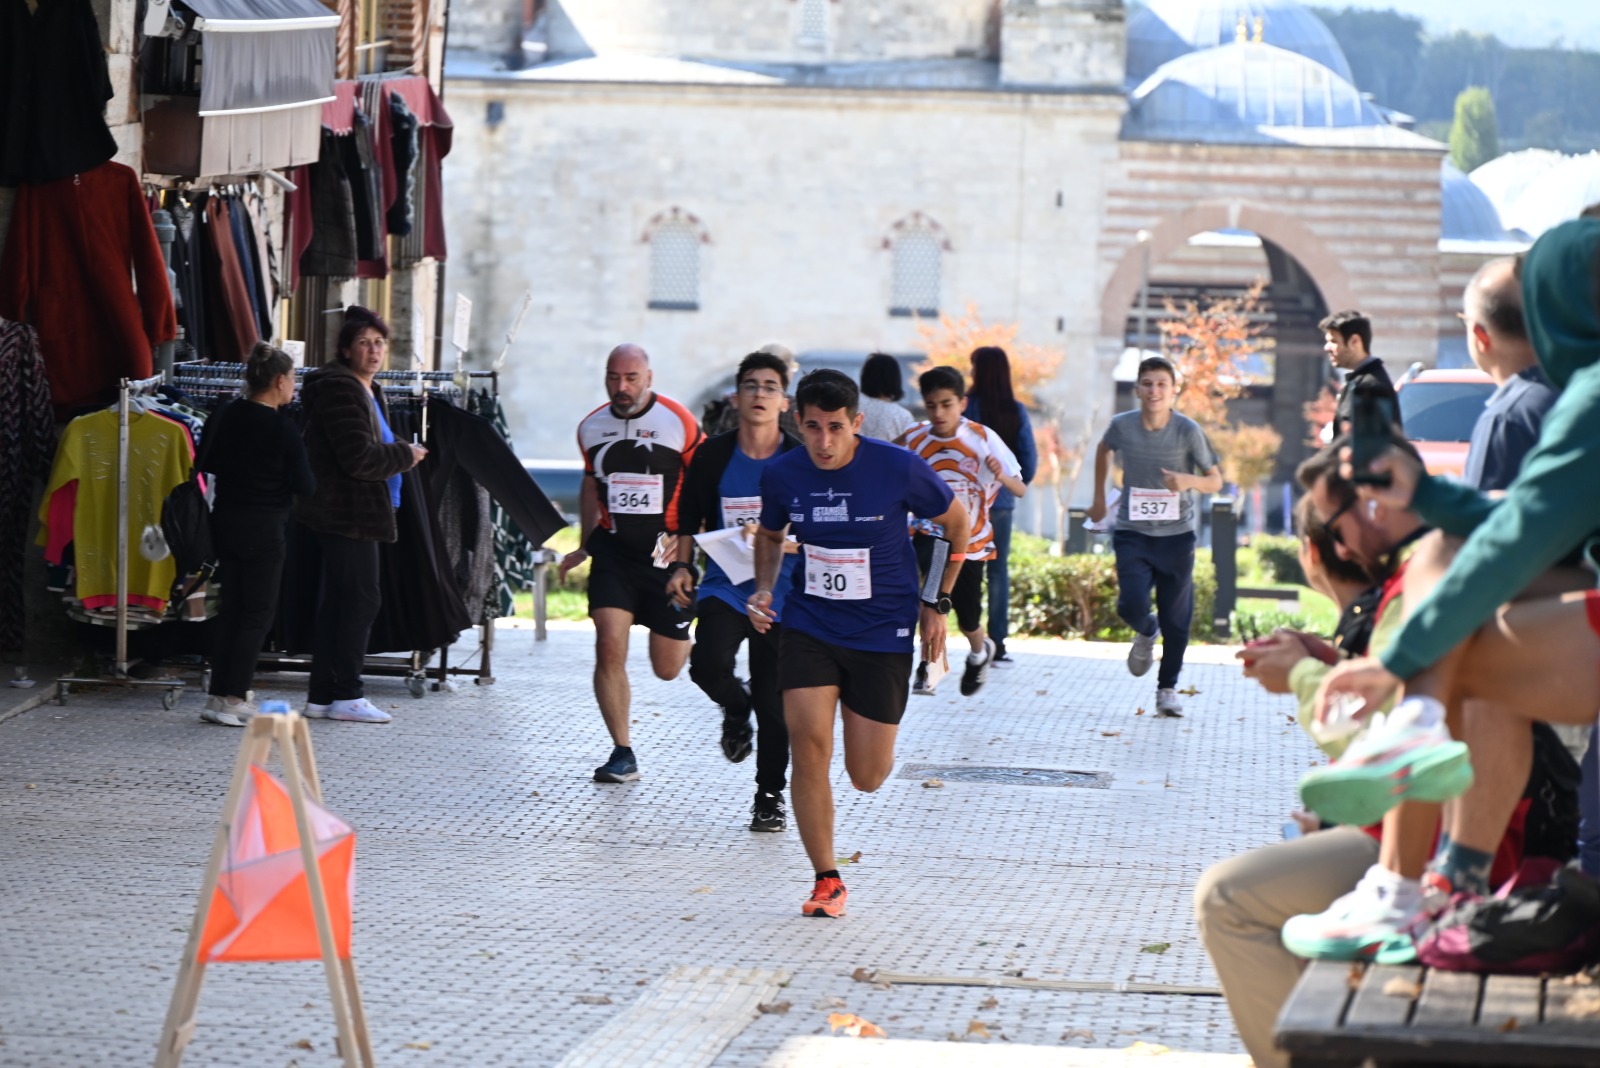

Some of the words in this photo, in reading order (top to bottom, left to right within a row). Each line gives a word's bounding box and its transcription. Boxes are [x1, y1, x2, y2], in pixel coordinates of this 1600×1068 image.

[618, 492, 651, 508] 364
[1140, 502, 1168, 515] 537
[822, 572, 847, 592] 30
